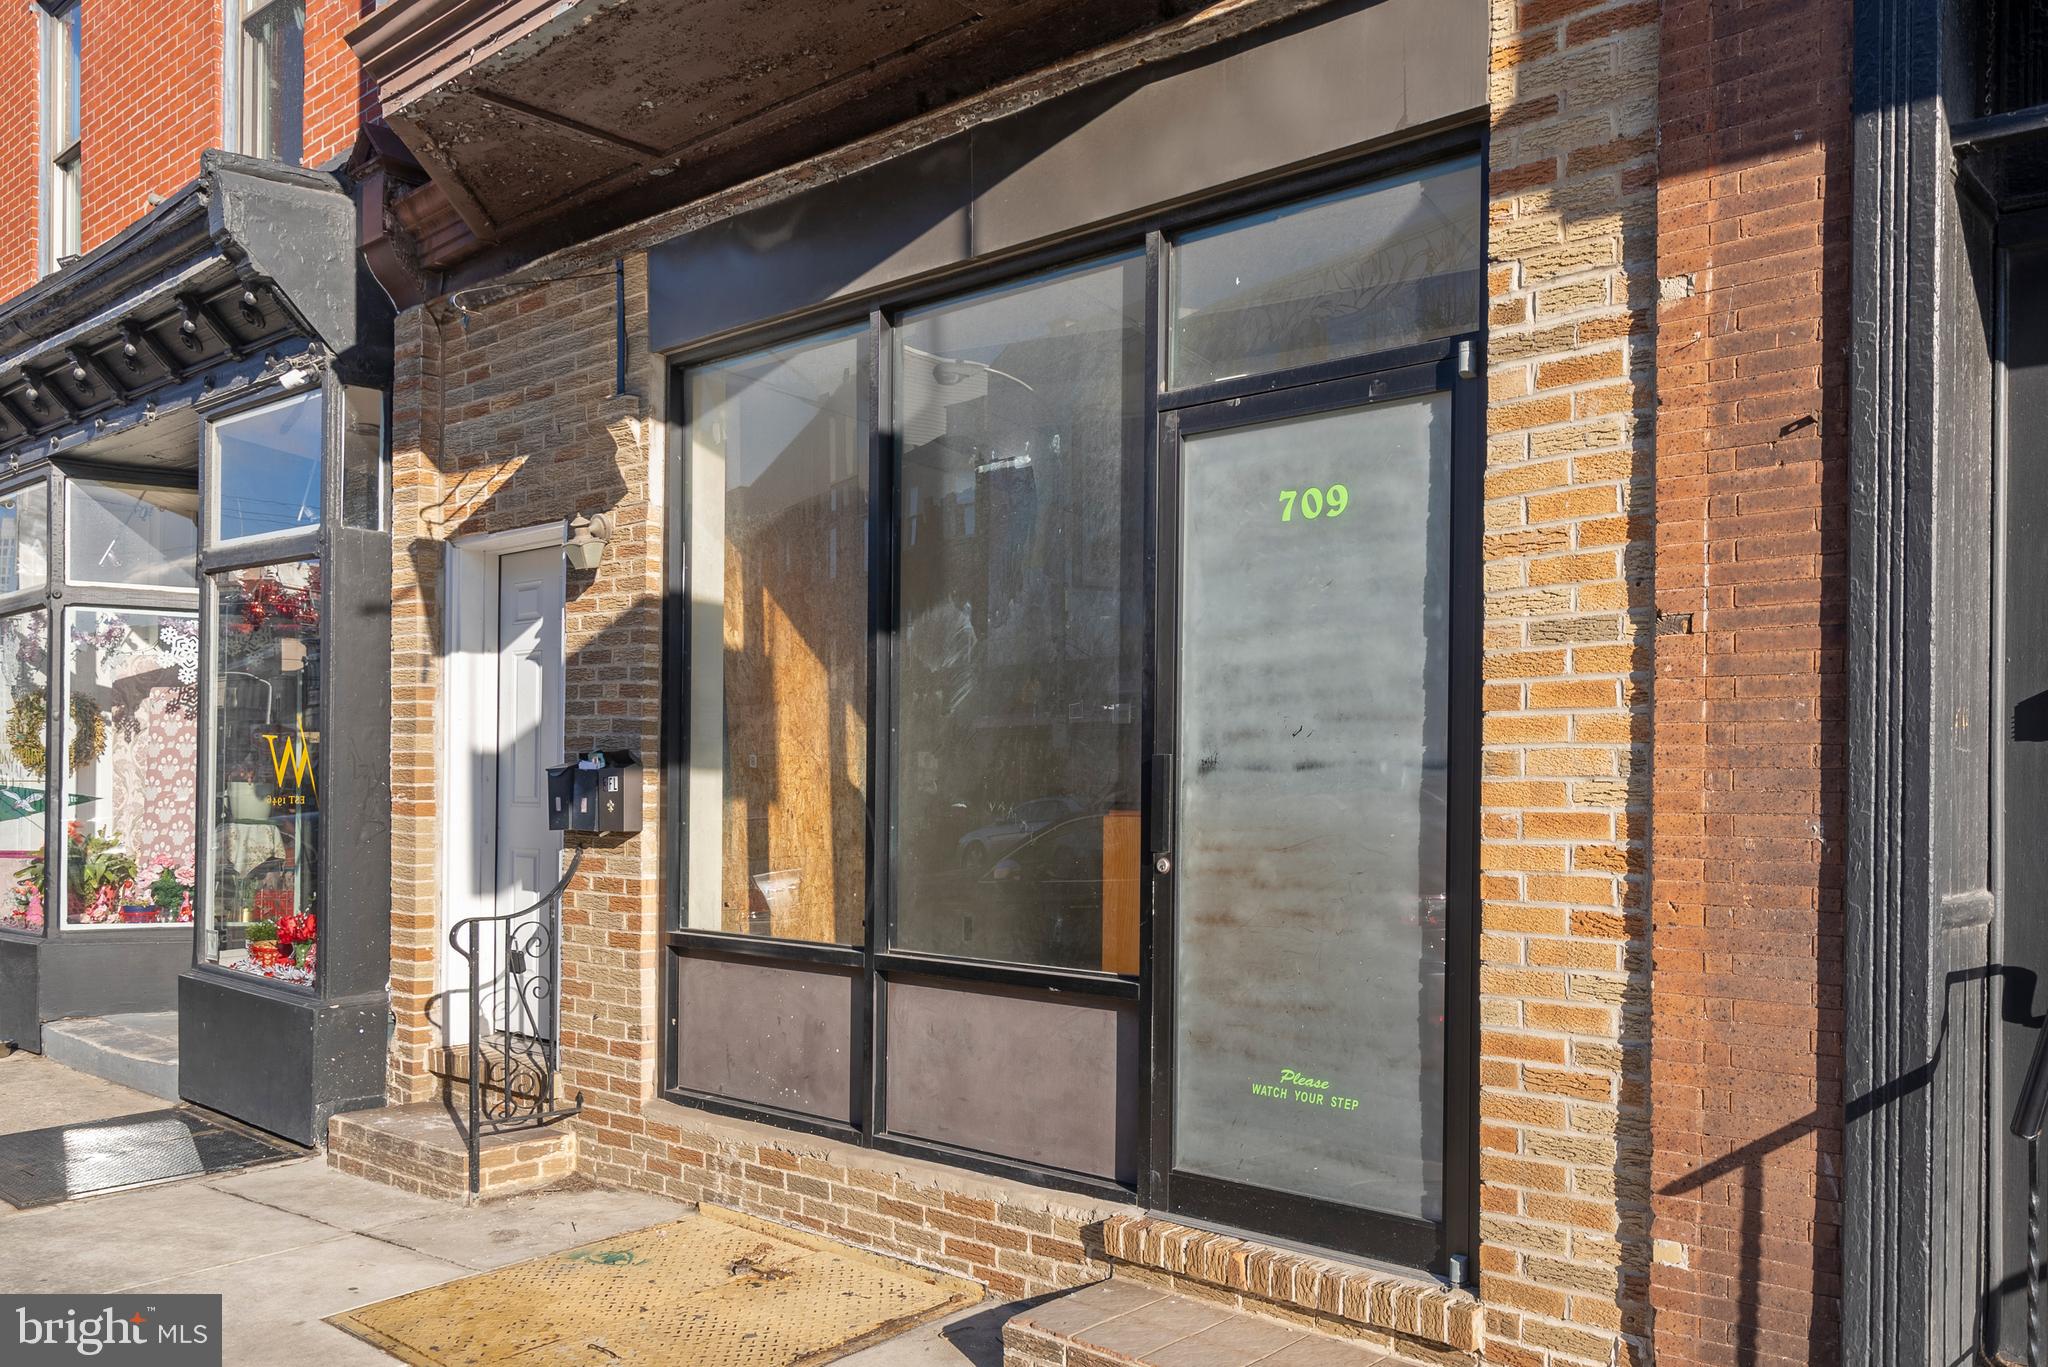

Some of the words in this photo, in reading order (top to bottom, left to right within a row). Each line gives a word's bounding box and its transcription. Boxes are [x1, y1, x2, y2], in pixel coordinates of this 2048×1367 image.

[1279, 484, 1349, 522] 709
[1280, 1069, 1329, 1089] Please
[1252, 1083, 1287, 1099] WATCH
[1294, 1090, 1323, 1105] YOUR
[1330, 1096, 1359, 1111] STEP
